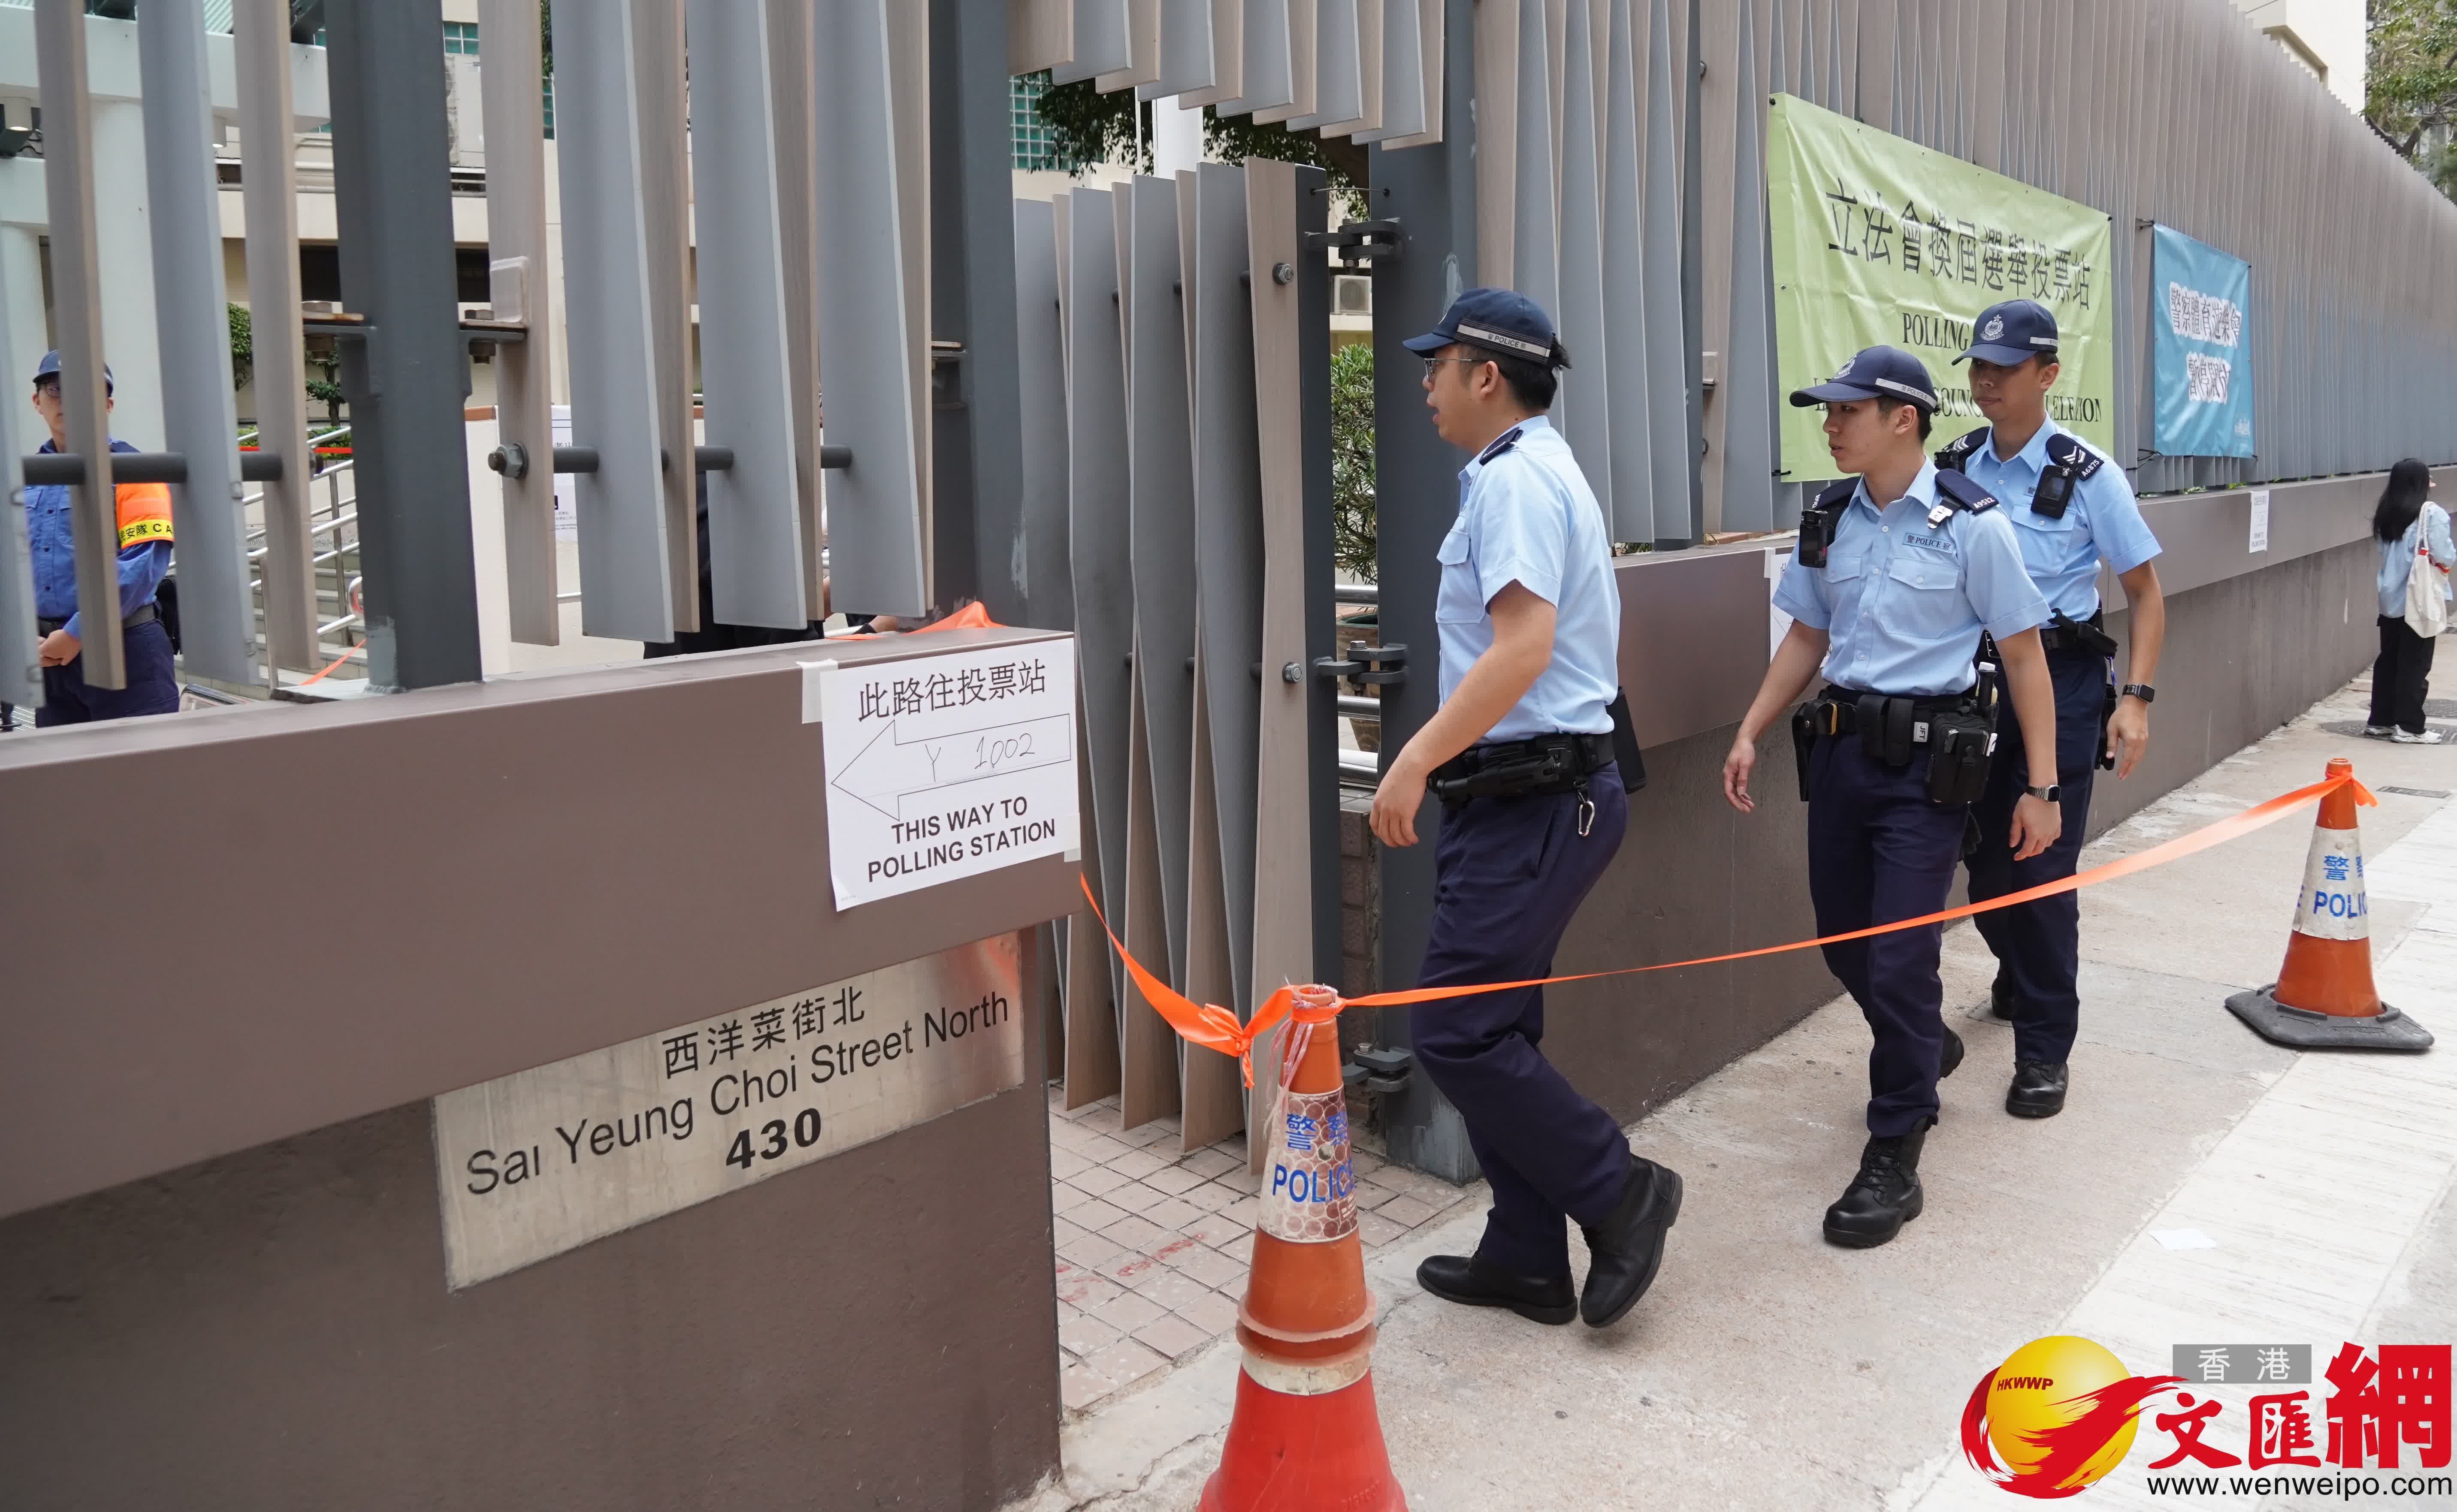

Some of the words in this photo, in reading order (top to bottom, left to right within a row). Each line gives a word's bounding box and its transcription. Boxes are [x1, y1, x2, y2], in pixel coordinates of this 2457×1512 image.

[1825, 177, 2091, 311] 立法會換屆選舉投票站
[1494, 335, 1520, 347] POLICE
[1902, 313, 1969, 351] POLLING
[1907, 388, 1924, 398] POLICE
[2081, 459, 2100, 477] A6875
[1973, 497, 1995, 509] A9512
[1915, 537, 1942, 548] POLICE
[858, 658, 1046, 722] 此路往投票站
[925, 744, 941, 782] Y
[974, 733, 1035, 770] 1002
[891, 815, 941, 845] THIS
[946, 803, 995, 832] WAY
[1000, 796, 1028, 818] TO
[868, 841, 964, 882] POLLING
[970, 818, 1055, 857] STATION
[662, 986, 866, 1080] 西洋菜街北
[555, 1097, 694, 1164] Yeung
[710, 1056, 797, 1115] Choi
[810, 1021, 913, 1084] Street
[924, 992, 1009, 1048] North
[725, 1108, 822, 1171] 430
